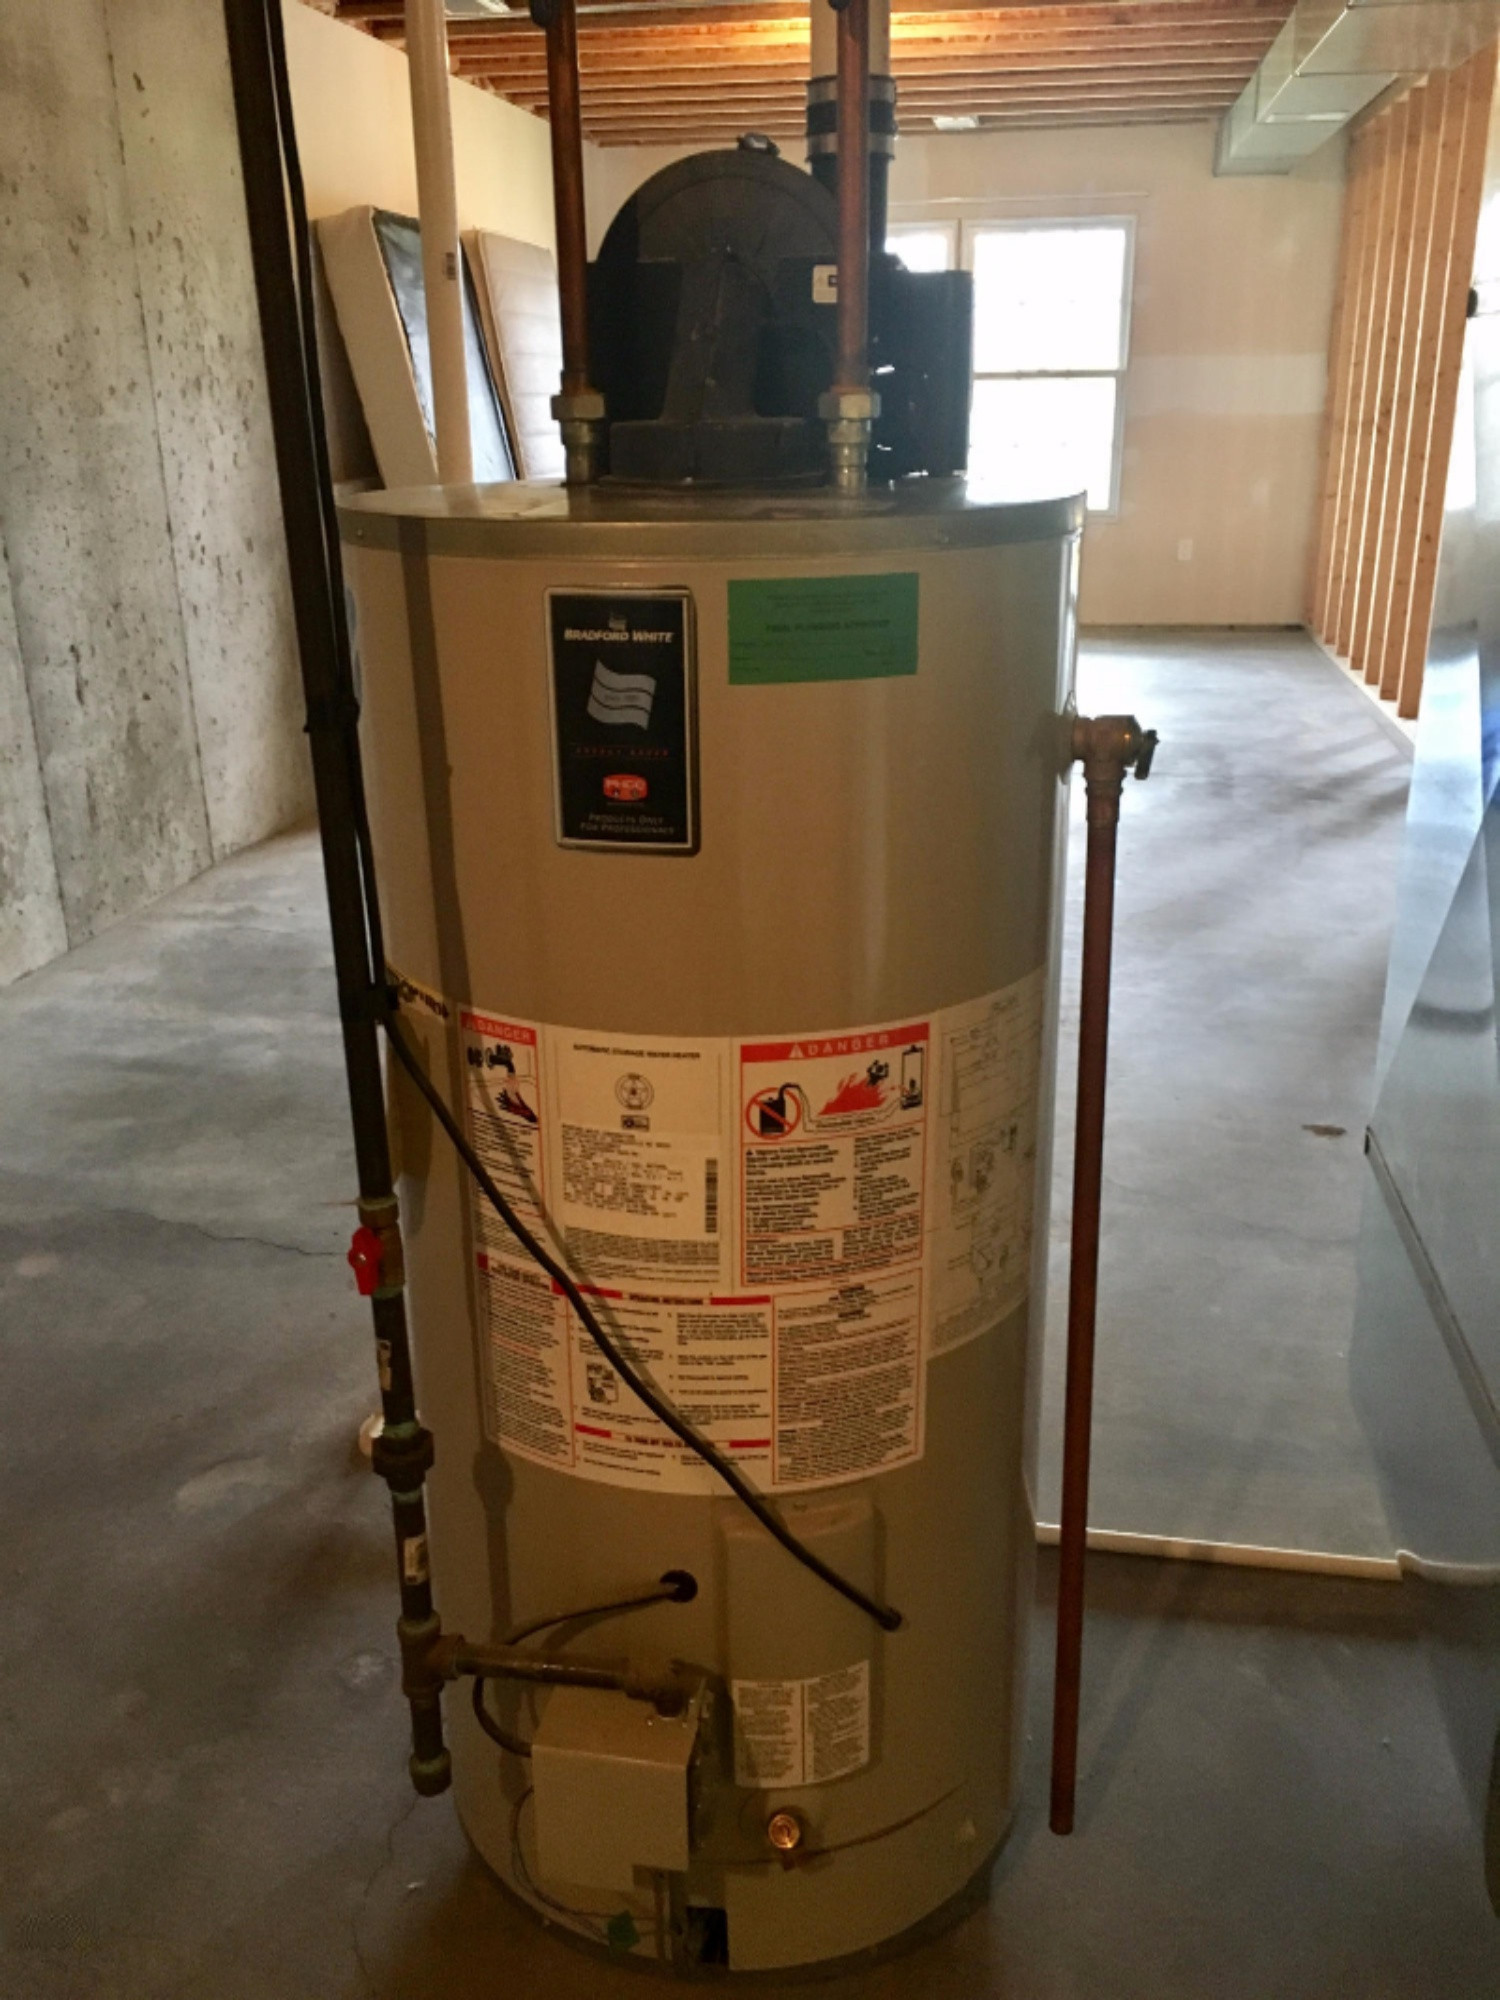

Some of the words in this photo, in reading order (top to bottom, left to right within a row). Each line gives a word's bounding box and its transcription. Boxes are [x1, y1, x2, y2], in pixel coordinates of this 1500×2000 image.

[564, 629, 629, 641] BRADFORD
[632, 630, 674, 643] WHITE
[477, 1018, 532, 1043] DANGER
[807, 1033, 890, 1056] DANGER
